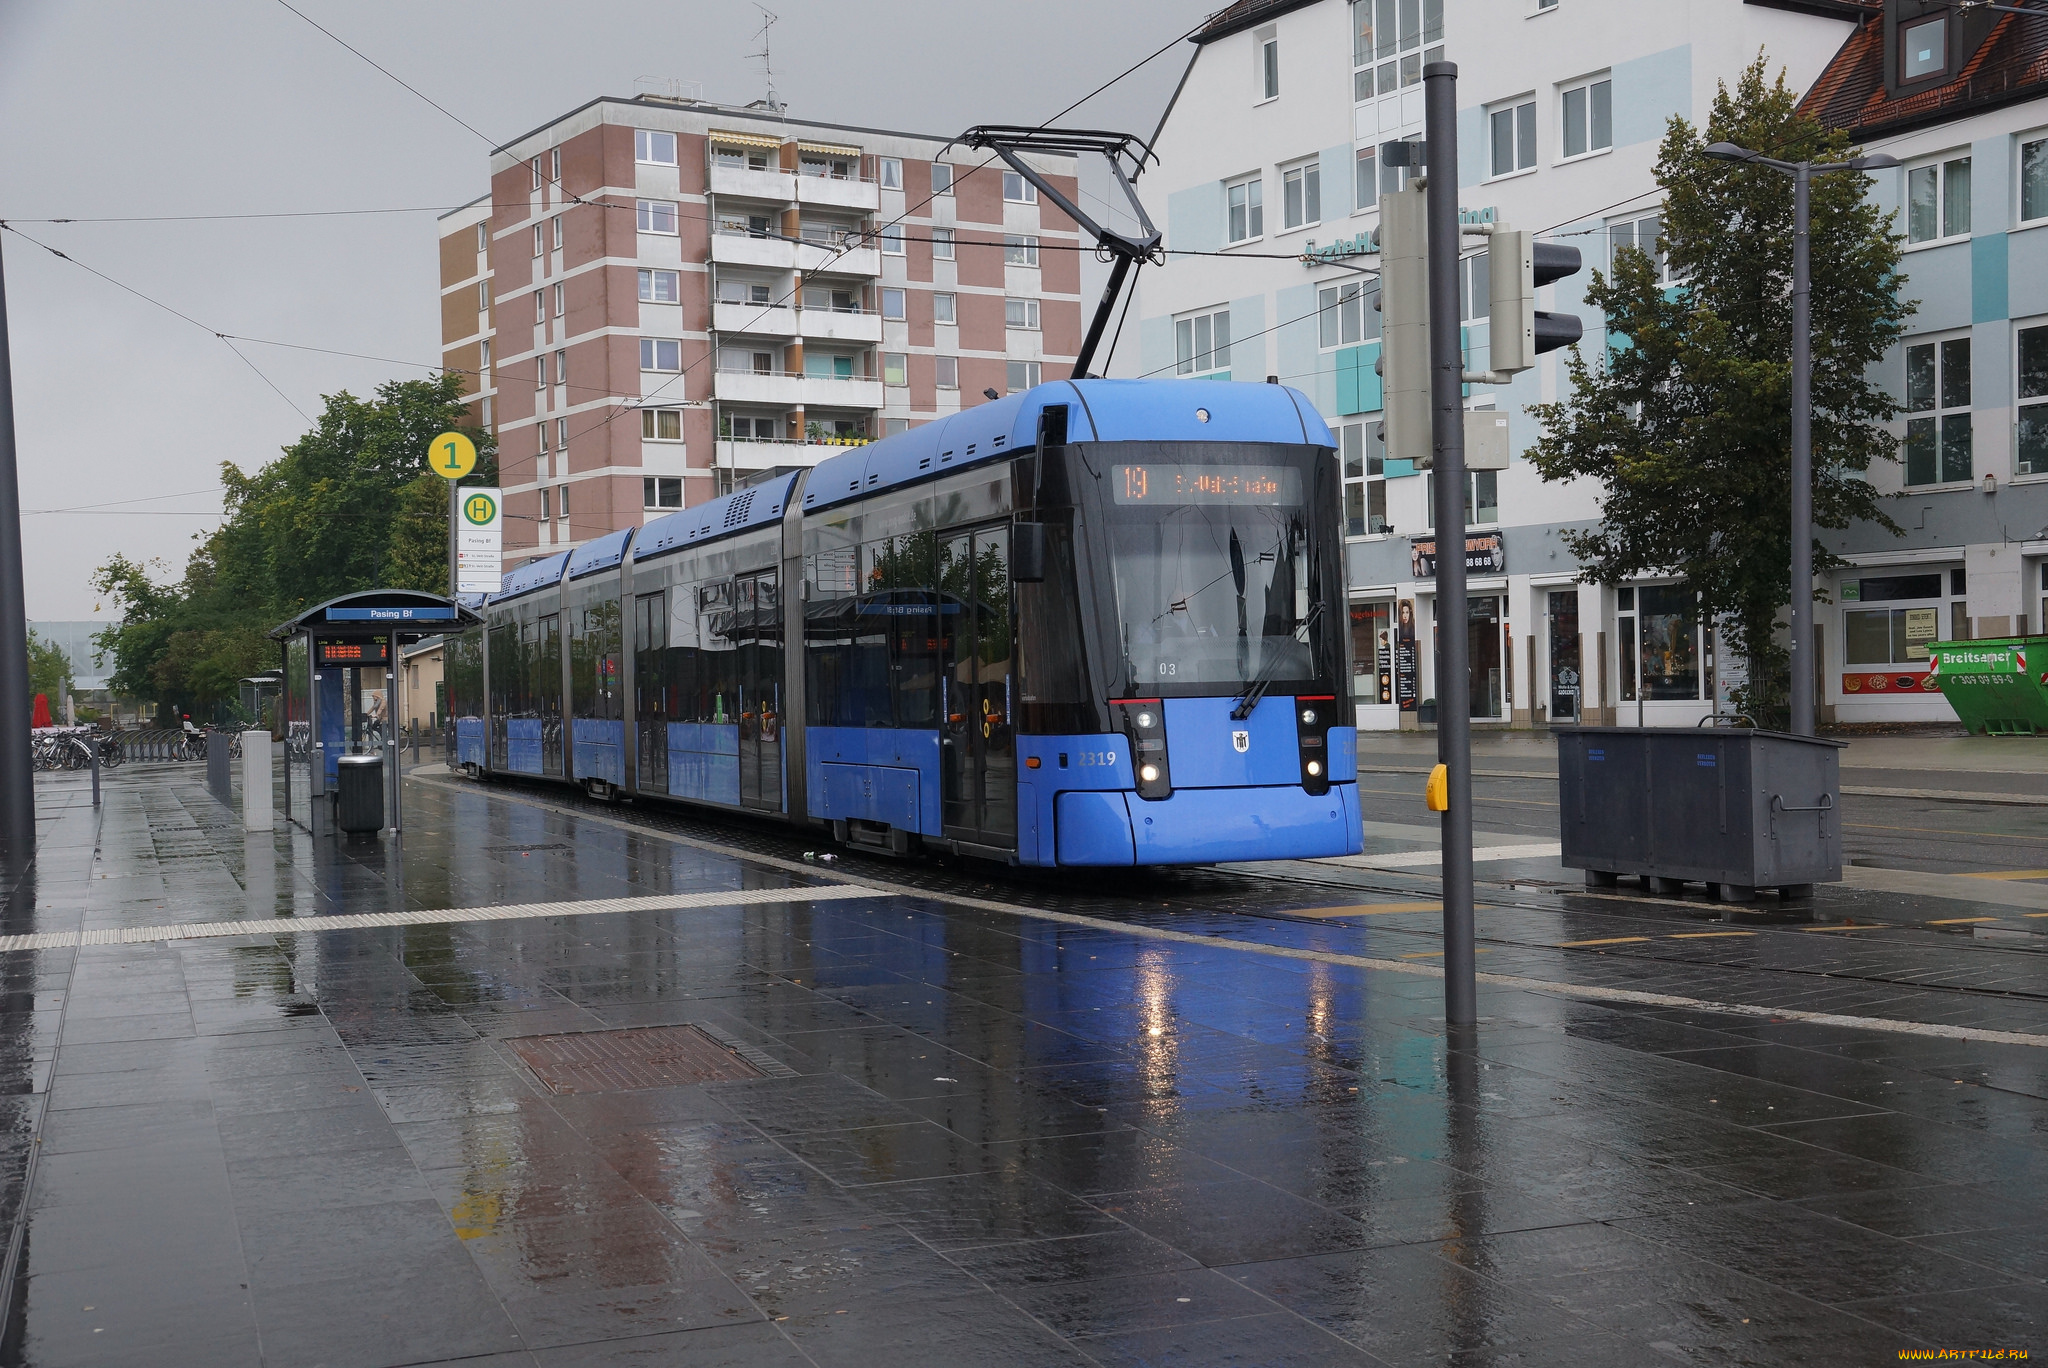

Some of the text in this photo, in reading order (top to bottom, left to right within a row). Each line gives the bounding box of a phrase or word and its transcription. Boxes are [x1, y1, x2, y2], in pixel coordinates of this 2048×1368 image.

[444, 442, 461, 469] 1
[1125, 467, 1147, 498] 19
[473, 500, 487, 519] H
[370, 609, 413, 619] Pasing Bf
[1943, 652, 2011, 664] Breitsamer
[1159, 663, 1176, 675] 03
[1078, 751, 1116, 766] 2319
